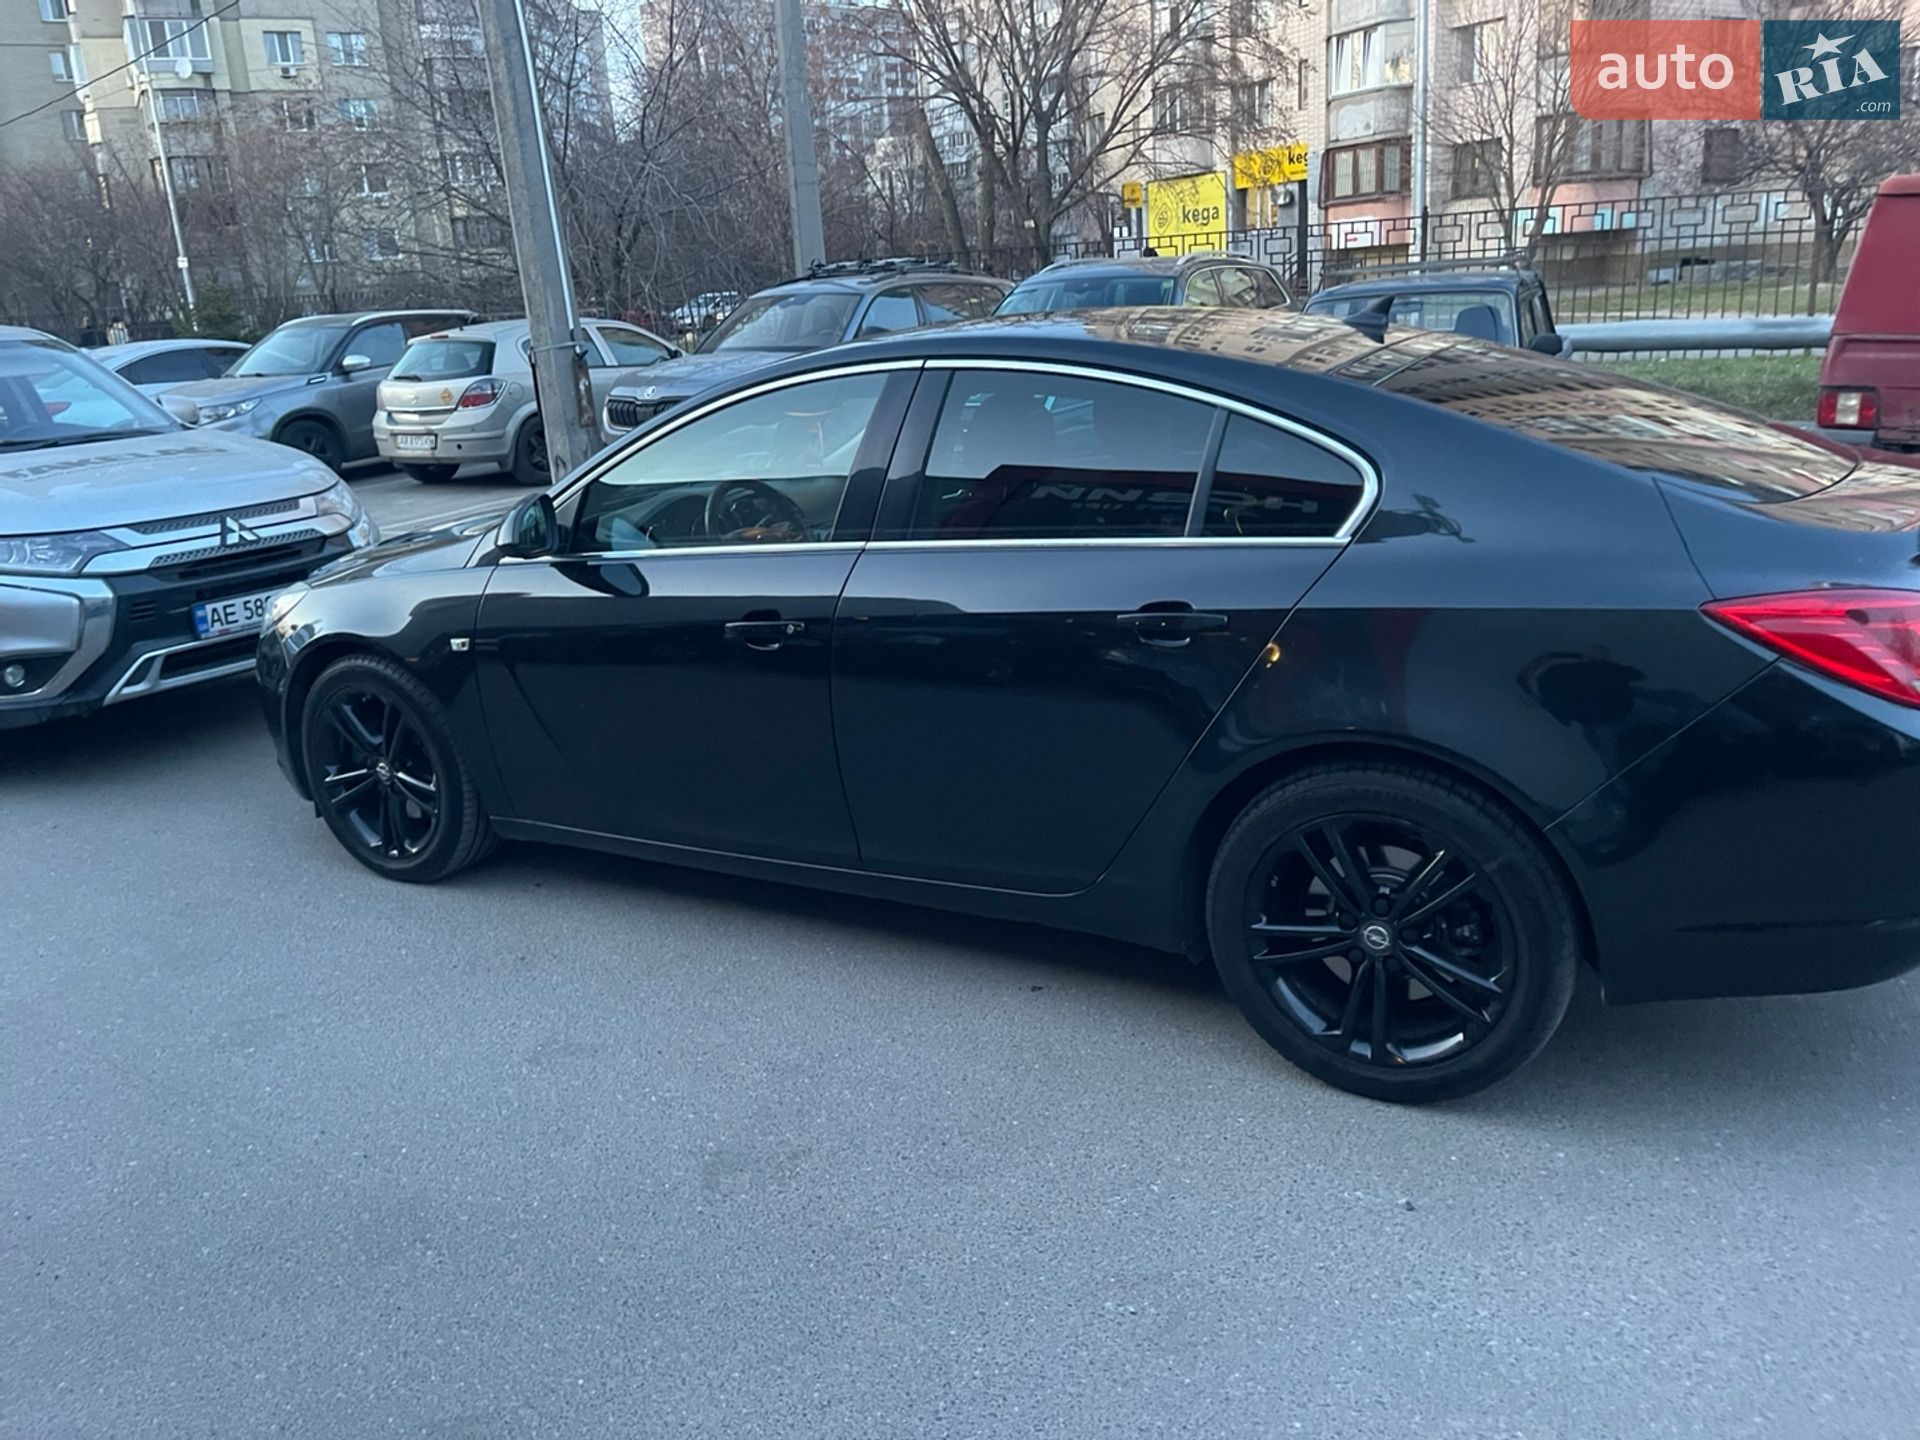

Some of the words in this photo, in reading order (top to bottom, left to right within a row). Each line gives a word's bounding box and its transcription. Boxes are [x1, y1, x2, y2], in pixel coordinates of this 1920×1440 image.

[1182, 204, 1220, 227] kega
[211, 603, 239, 628] AE
[243, 596, 271, 620] 58
